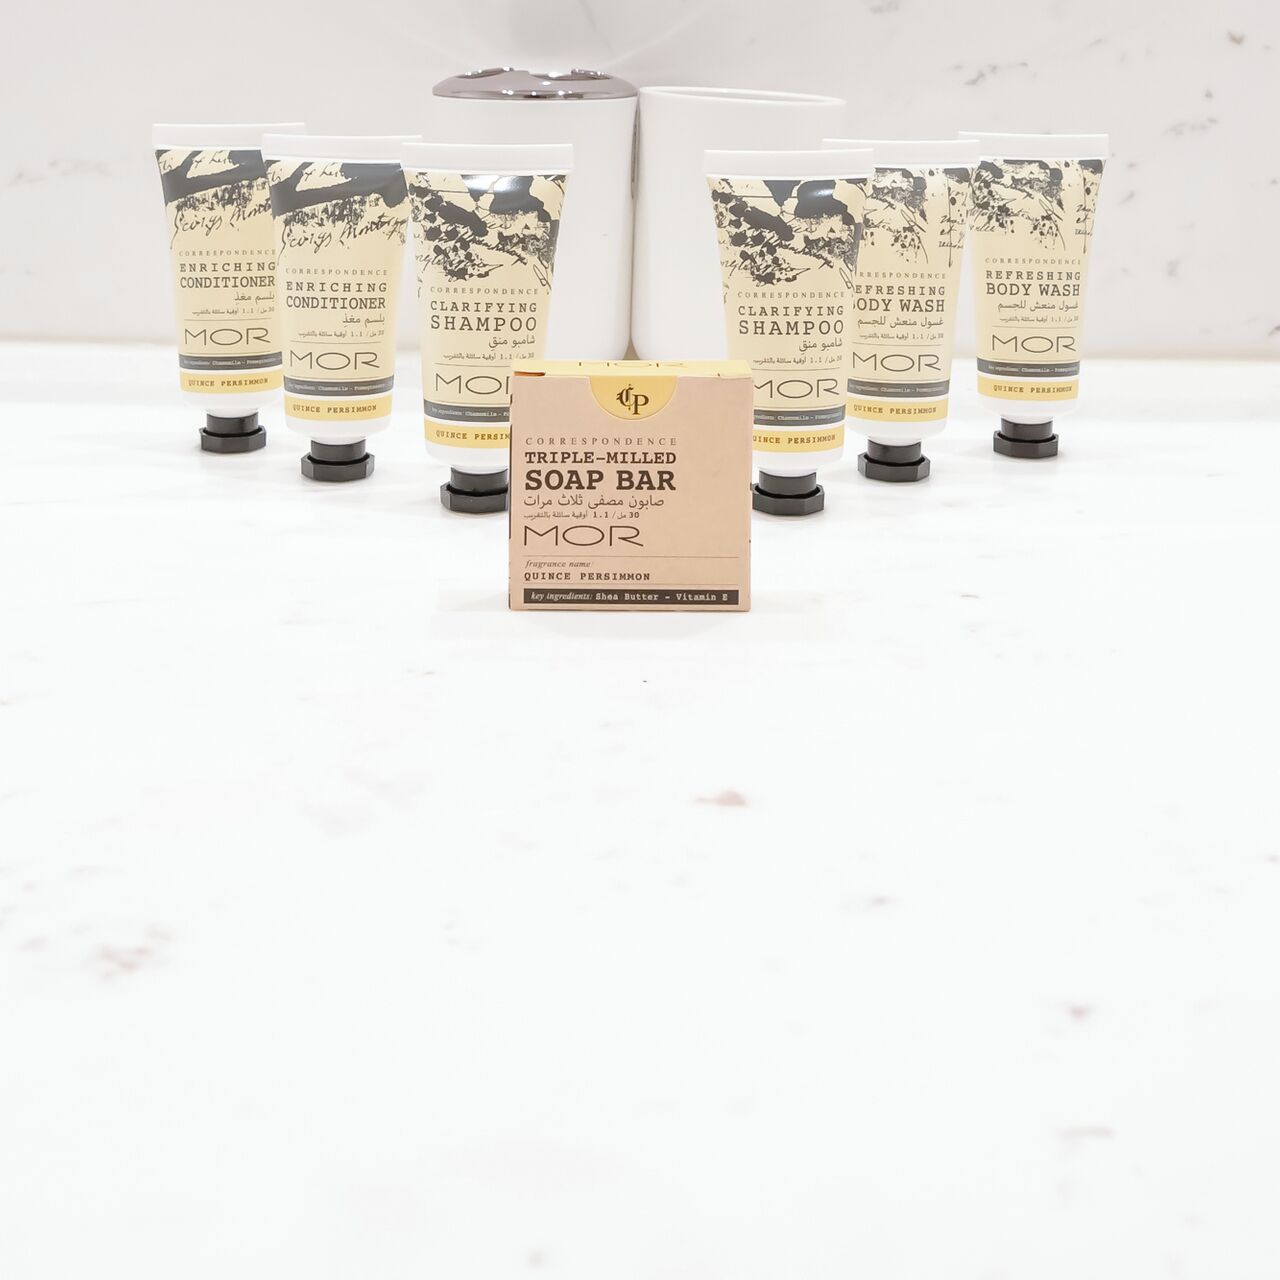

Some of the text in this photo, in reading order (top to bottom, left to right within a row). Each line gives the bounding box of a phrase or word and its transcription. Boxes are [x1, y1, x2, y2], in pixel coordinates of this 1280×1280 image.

[180, 262, 275, 272] ENRICHING
[986, 270, 1080, 280] REFRESHING
[180, 276, 275, 288] CONDITIONER
[286, 281, 387, 292] ENRICHING
[855, 285, 945, 295] EFRESHING
[987, 283, 1080, 296] BODY WASH
[286, 296, 386, 309] CONDITIONER
[431, 301, 537, 313] CLARIFYING
[853, 298, 944, 312] ODY WASH
[738, 306, 843, 316] CLARIFYING
[431, 315, 537, 331] SHAMPOO
[739, 320, 843, 335] SHAMPOO
[185, 328, 270, 345] MOR
[993, 334, 1076, 353] MOR
[291, 350, 380, 370] MOR
[853, 352, 941, 372] MOR
[436, 373, 510, 394] MO
[328, 405, 376, 413] PERSIMMON
[436, 430, 467, 439] QUINCE
[788, 435, 835, 444] PERSIMMON
[526, 437, 676, 446] CORRESPONDENCE
[525, 452, 676, 464] TRIPLE-MILLED
[525, 470, 676, 490] SOAP BAR
[524, 495, 552, 509] مرات
[558, 494, 583, 506] ثلاث
[628, 494, 664, 509] صابون
[524, 525, 643, 546] MOR
[526, 560, 566, 568] fragrance
[524, 572, 650, 581] QUINCE PERSIMMON
[531, 592, 545, 601] key
[625, 593, 658, 601] Butter
